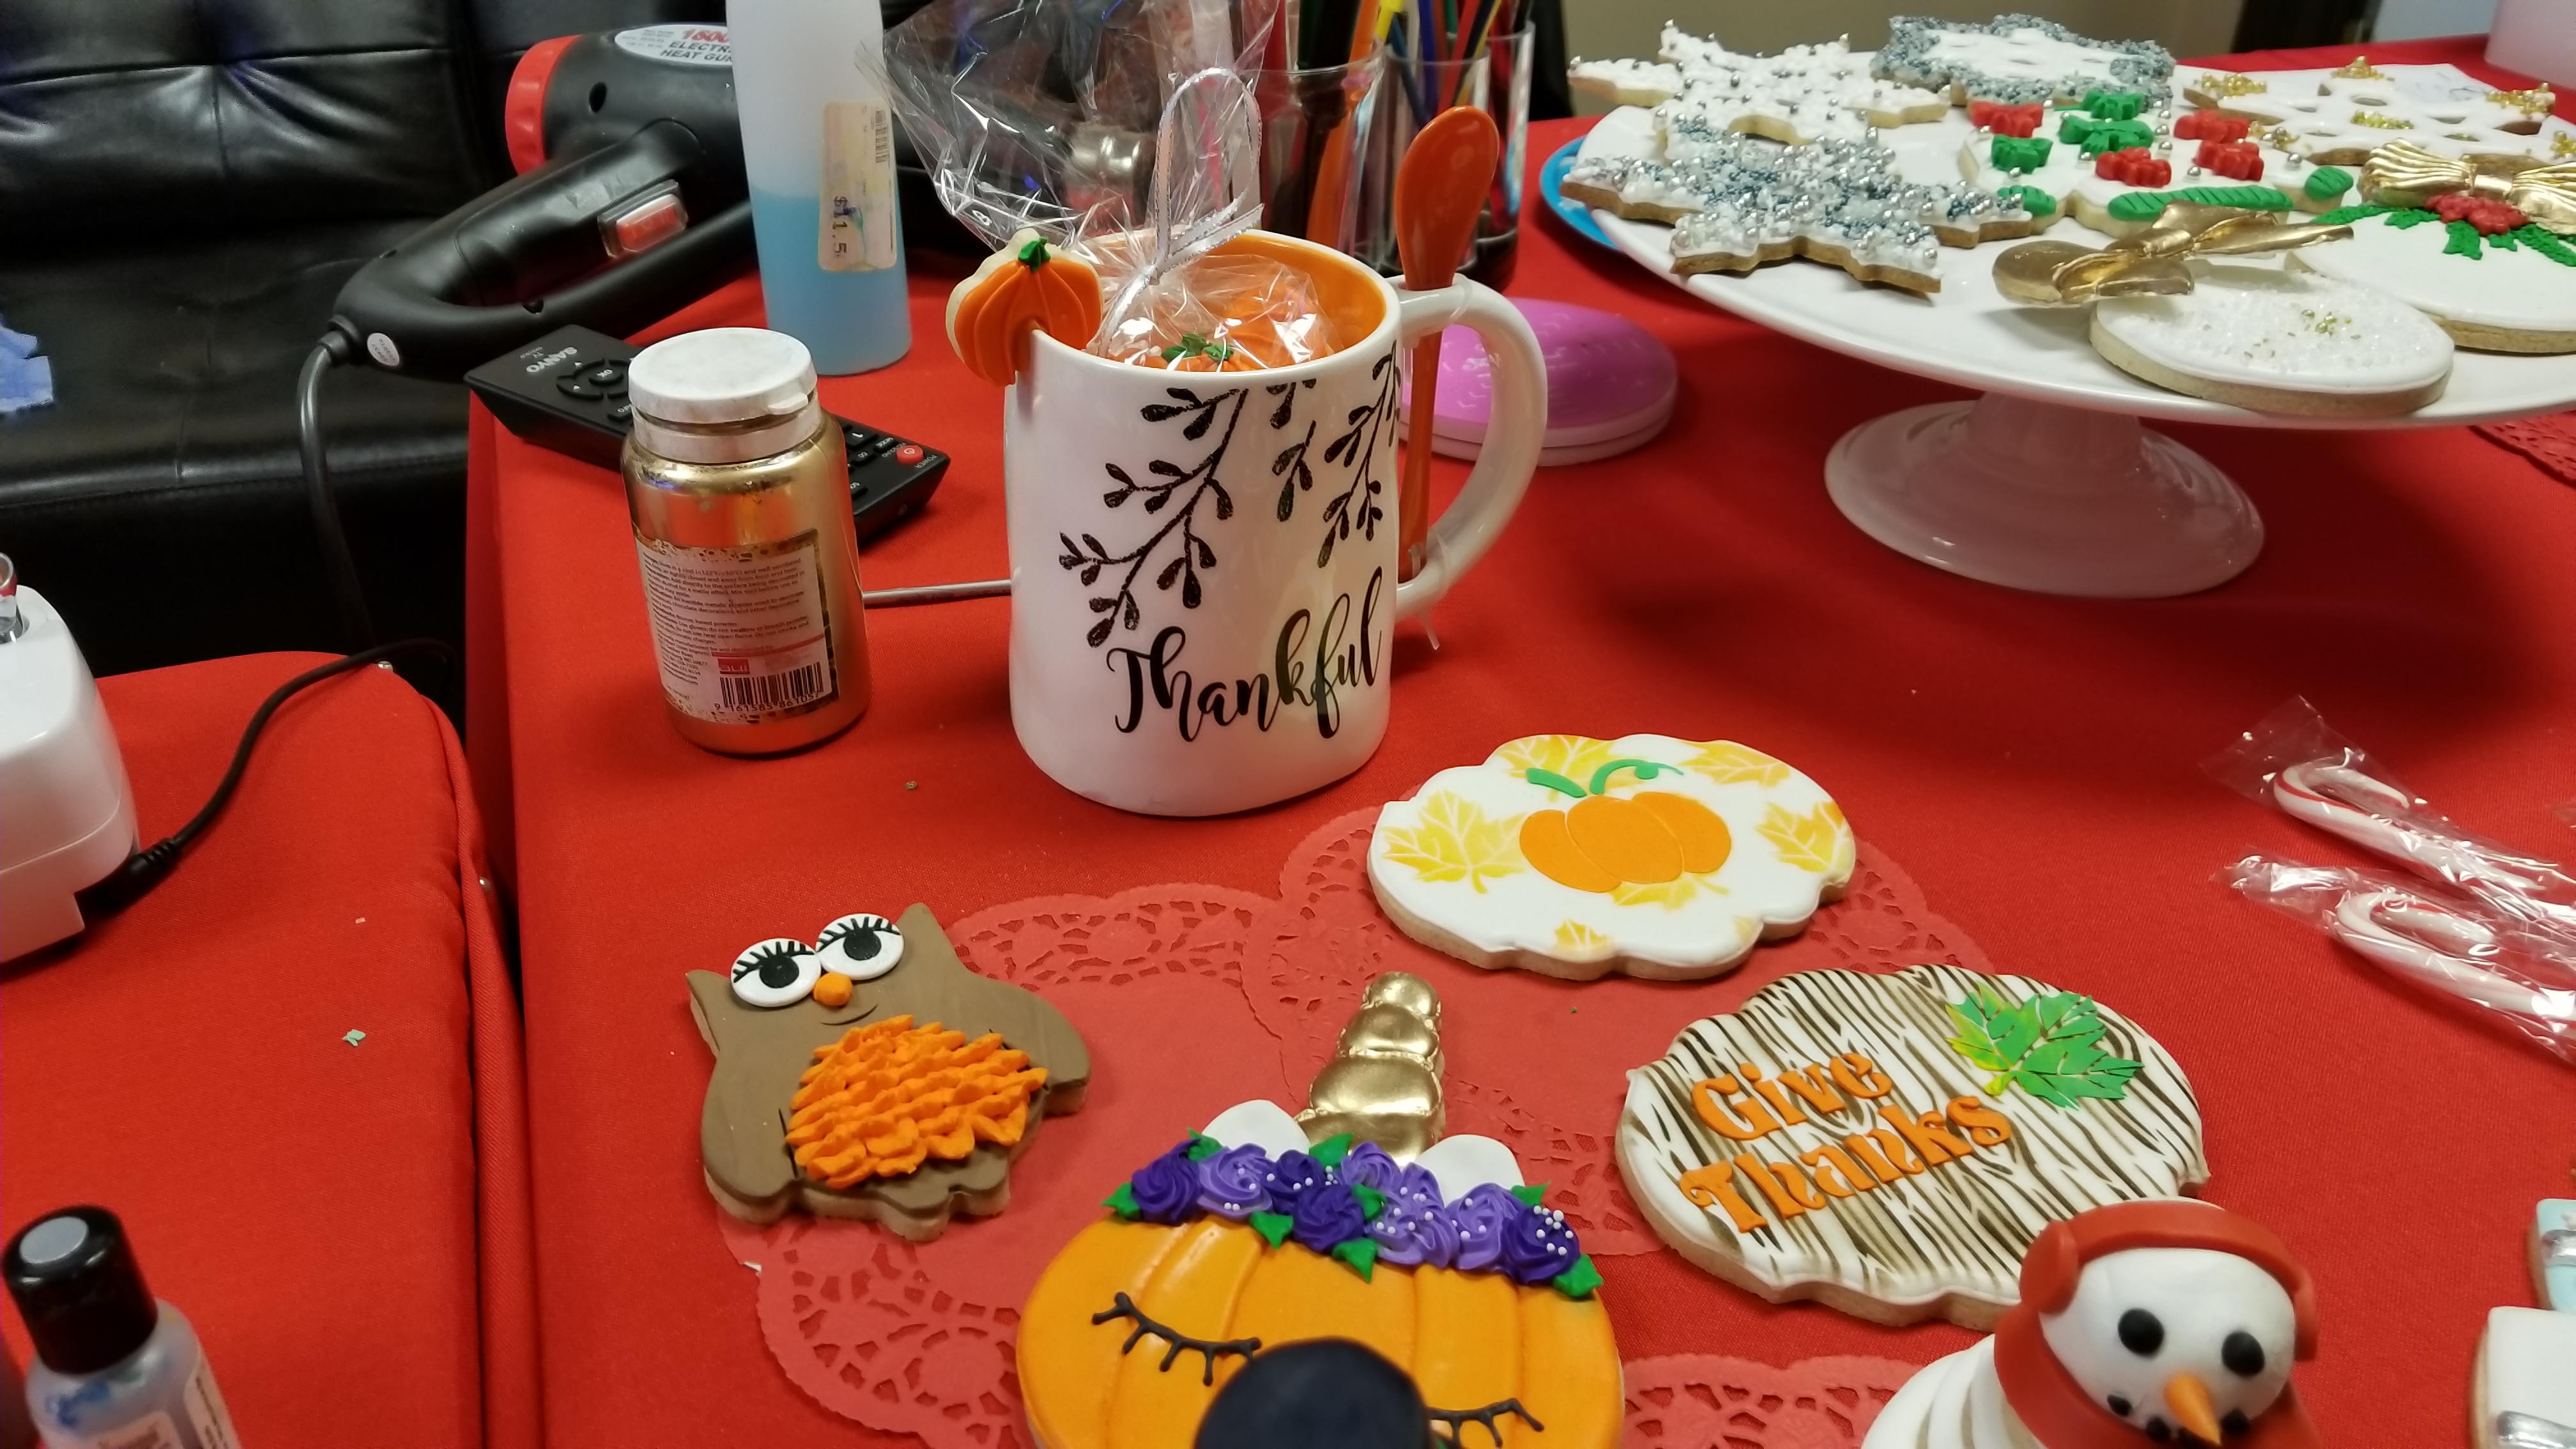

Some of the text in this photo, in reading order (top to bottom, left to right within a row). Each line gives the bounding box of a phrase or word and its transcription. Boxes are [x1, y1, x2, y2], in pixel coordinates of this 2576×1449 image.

[660, 50, 702, 59] HEAT
[670, 42, 731, 52] ELECTR
[526, 346, 577, 372] SANYO
[914, 454, 937, 468] POWER
[1107, 565, 1383, 742] Thankful
[1691, 1052, 1893, 1140] Give
[1680, 1096, 2011, 1233] Thanks
